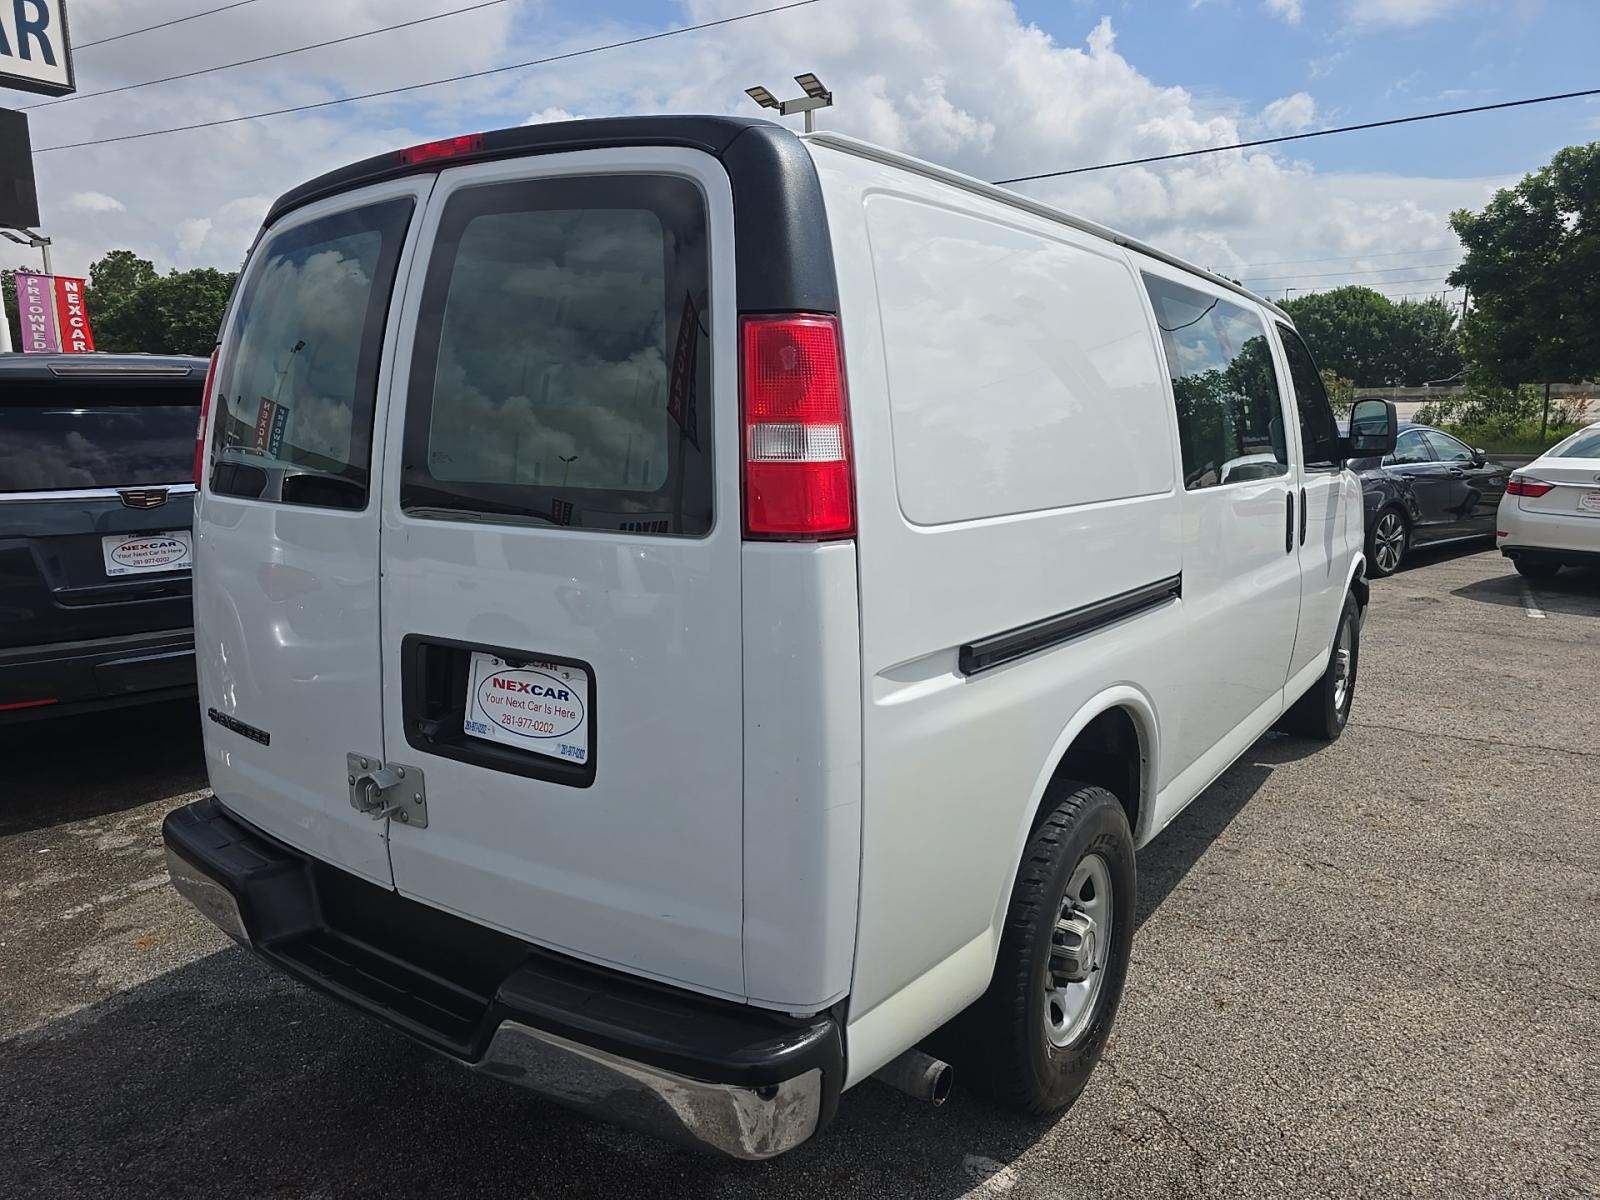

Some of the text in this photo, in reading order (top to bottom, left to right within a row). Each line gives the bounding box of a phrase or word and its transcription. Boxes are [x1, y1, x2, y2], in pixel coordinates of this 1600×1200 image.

[27, 277, 47, 349] PREOWNED
[64, 281, 86, 351] NEXCAR
[121, 542, 176, 552] NEXCAR
[492, 677, 570, 702] NEXCAR
[485, 692, 576, 719] Your Next Car Is Here
[501, 713, 554, 734] 281-977-0202
